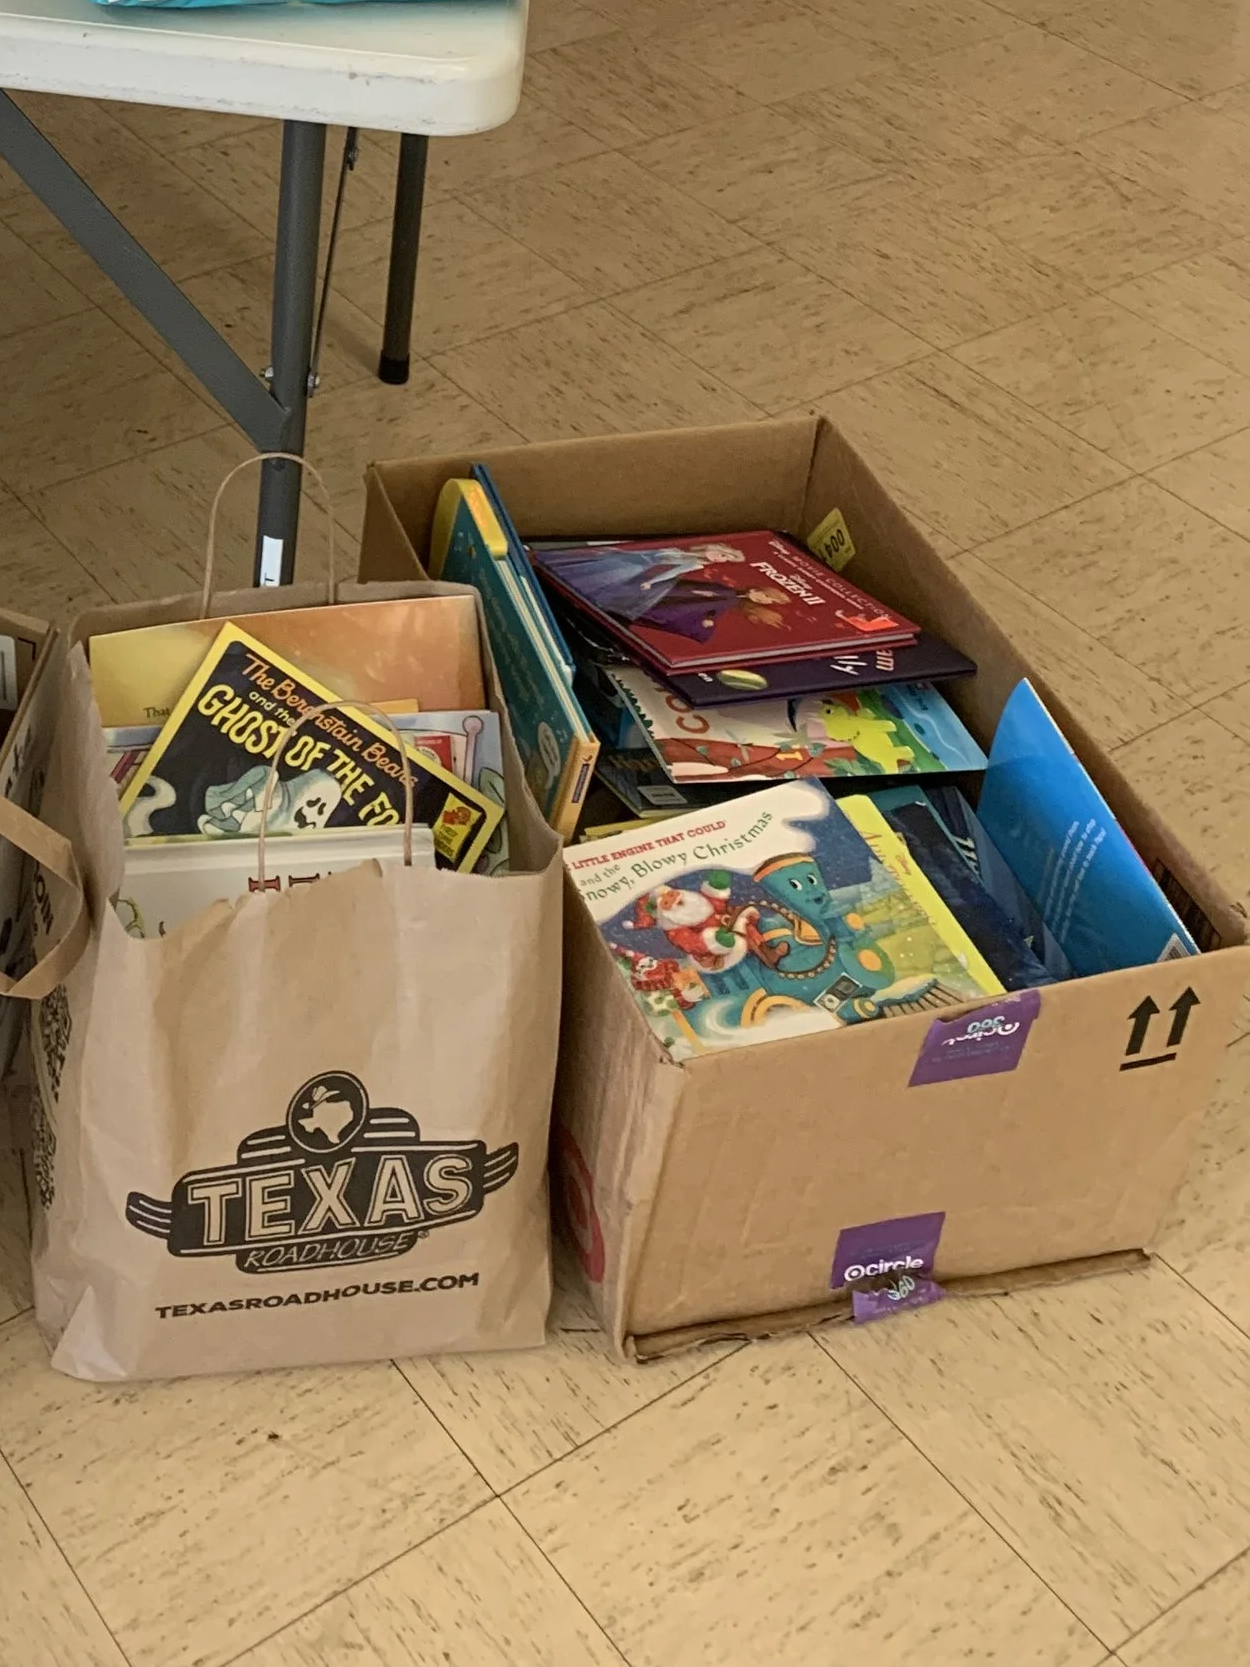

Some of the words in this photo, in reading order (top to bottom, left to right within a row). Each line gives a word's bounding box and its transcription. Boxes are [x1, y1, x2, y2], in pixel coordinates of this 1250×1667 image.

[750, 561, 811, 601] FROZEN
[242, 653, 275, 692] The
[248, 689, 275, 712] and
[273, 704, 297, 728] the
[197, 683, 293, 760] GHOST
[285, 735, 327, 773] OF
[326, 748, 375, 806] THE
[571, 853, 612, 871] LITTLE
[610, 841, 656, 862] ENGINE
[655, 831, 686, 848] THAT
[686, 819, 727, 838] COULD
[583, 875, 635, 902] nowy,
[630, 850, 689, 880] Blowy
[692, 809, 774, 861] Christmas
[579, 872, 601, 887] and
[602, 862, 622, 878] the
[187, 1152, 474, 1247] TEXAS
[243, 1231, 410, 1269] ROADHOUSE
[154, 1271, 480, 1320] TEXASROADHOUSE.COM
